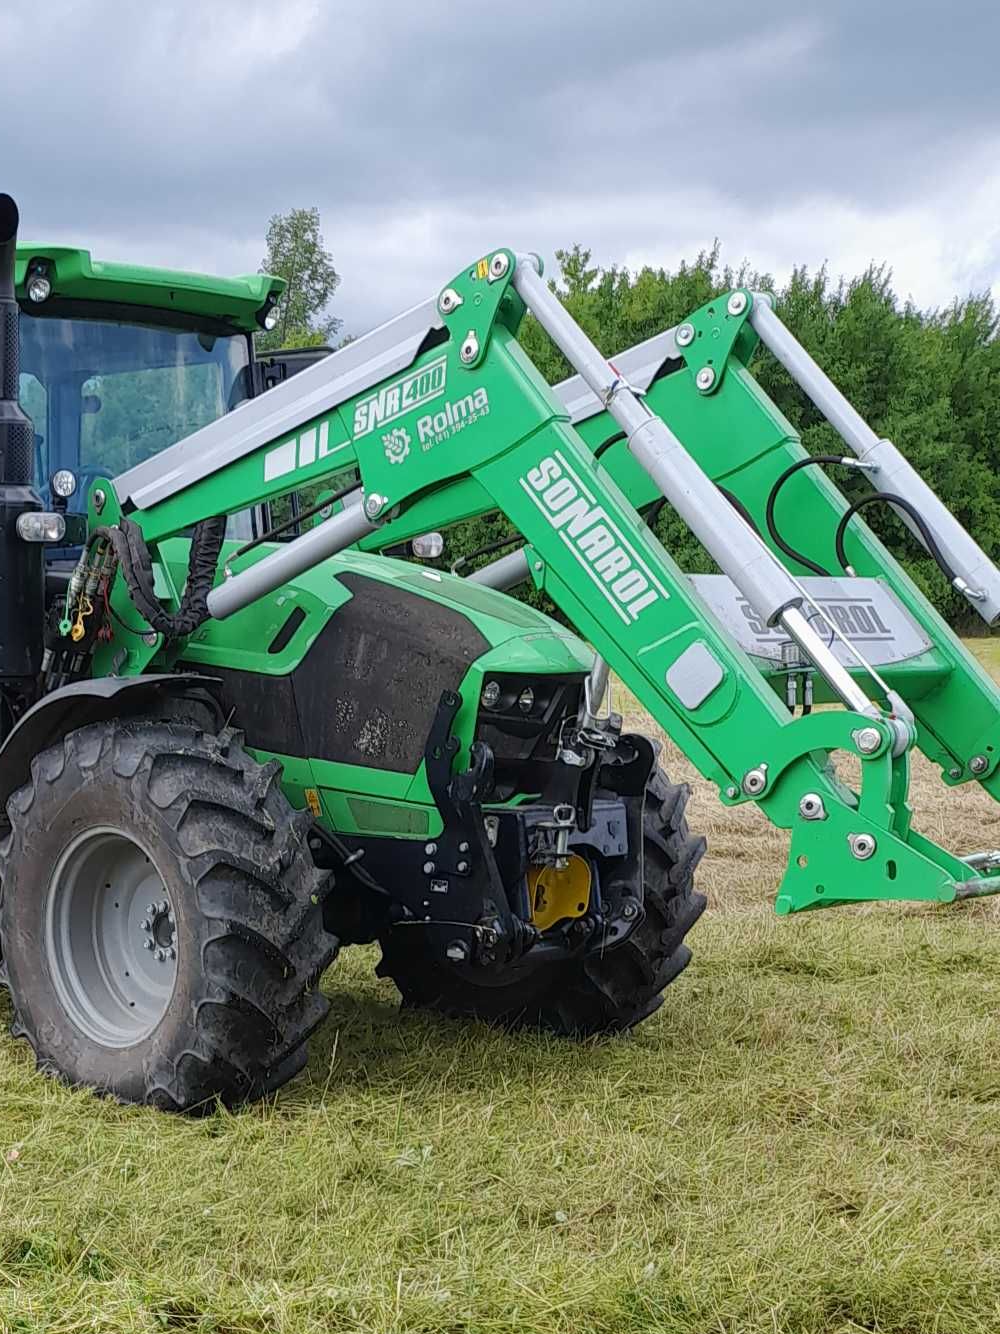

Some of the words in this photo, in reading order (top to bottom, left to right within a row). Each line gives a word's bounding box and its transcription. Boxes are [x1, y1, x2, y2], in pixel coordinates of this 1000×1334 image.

[403, 364, 445, 405] 400
[417, 387, 489, 442] Rolma
[527, 456, 659, 620] SONAROL
